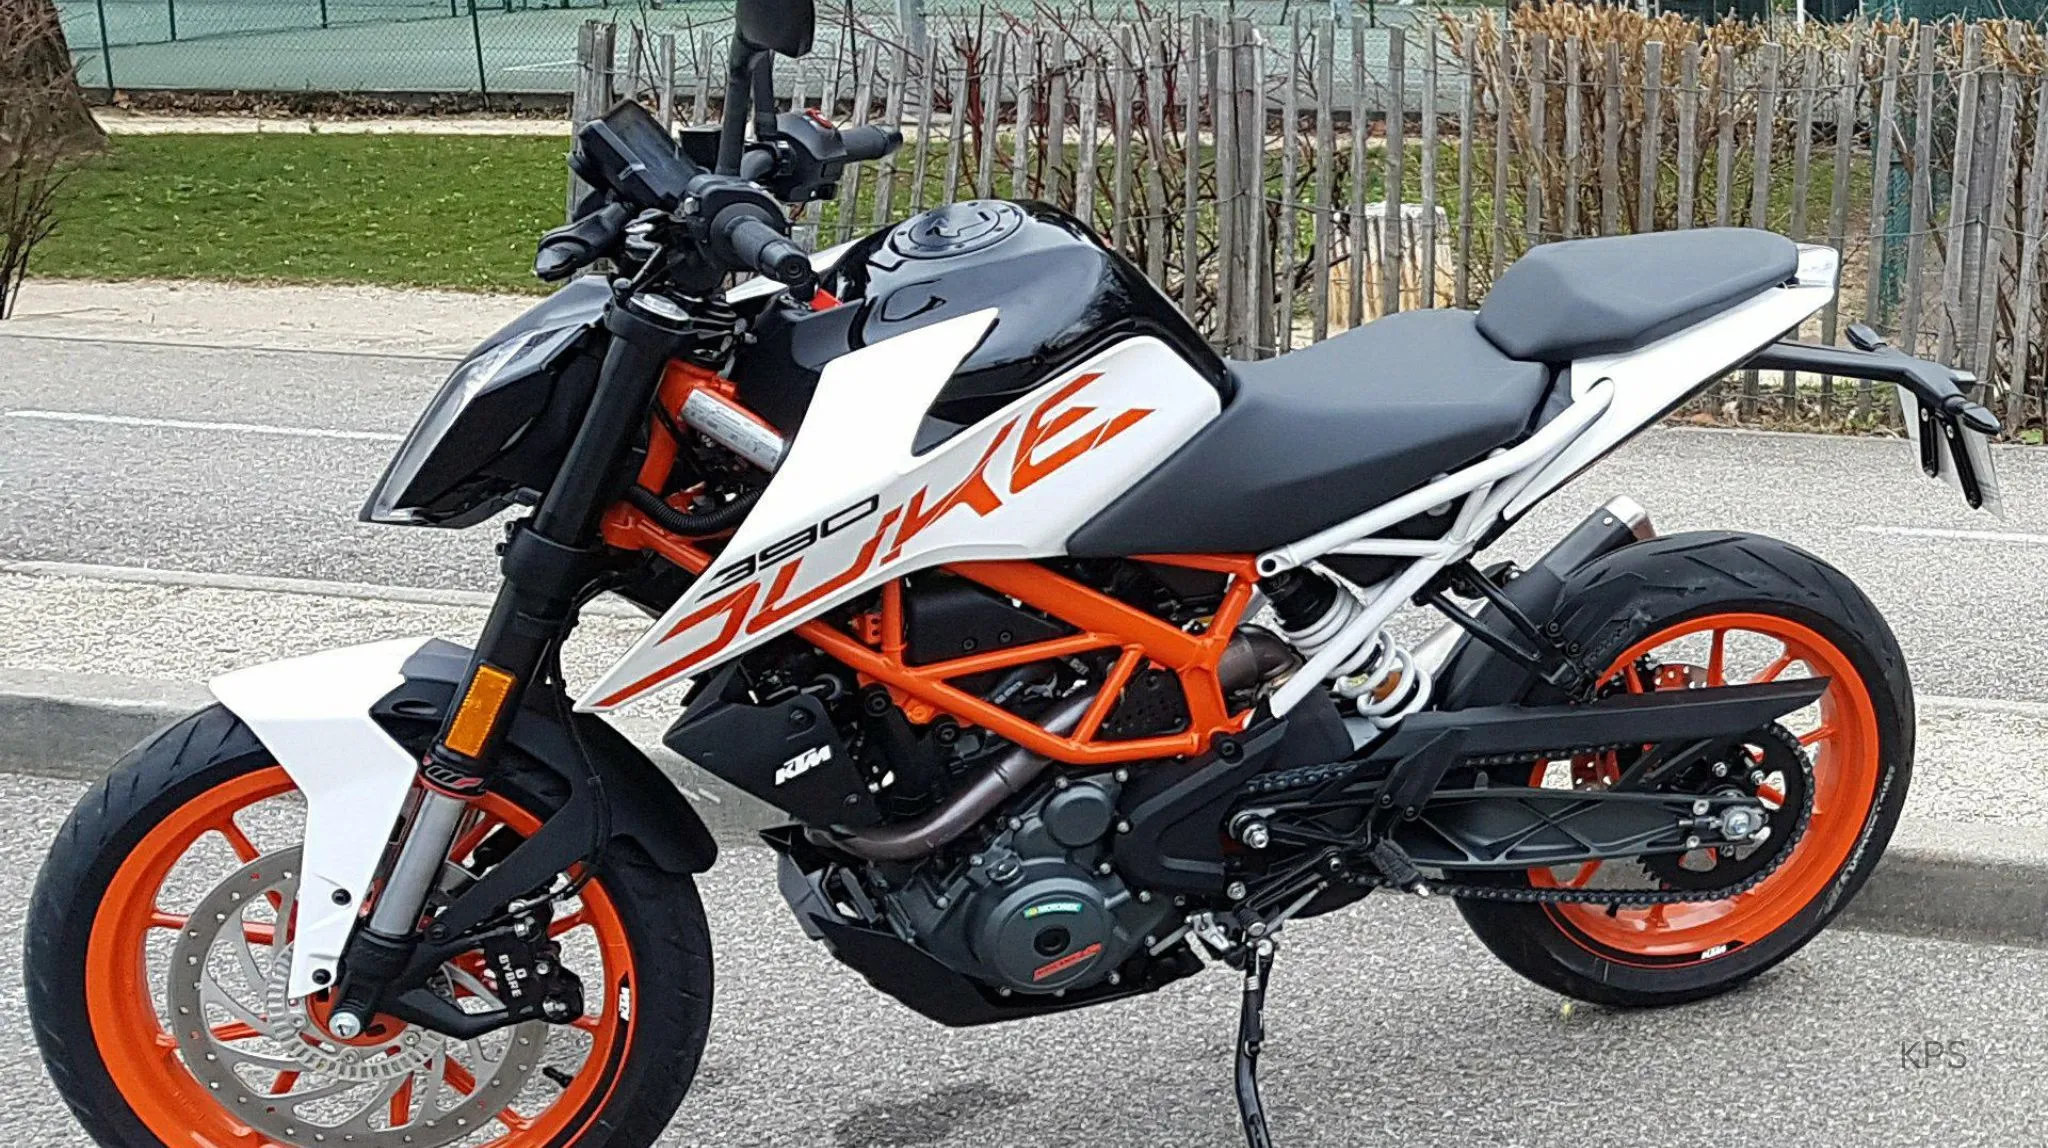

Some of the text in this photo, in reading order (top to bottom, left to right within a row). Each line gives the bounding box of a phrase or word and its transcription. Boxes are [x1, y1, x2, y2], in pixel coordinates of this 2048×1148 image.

[592, 372, 1156, 708] DUKE
[694, 493, 880, 604] 390
[775, 744, 832, 786] KTM
